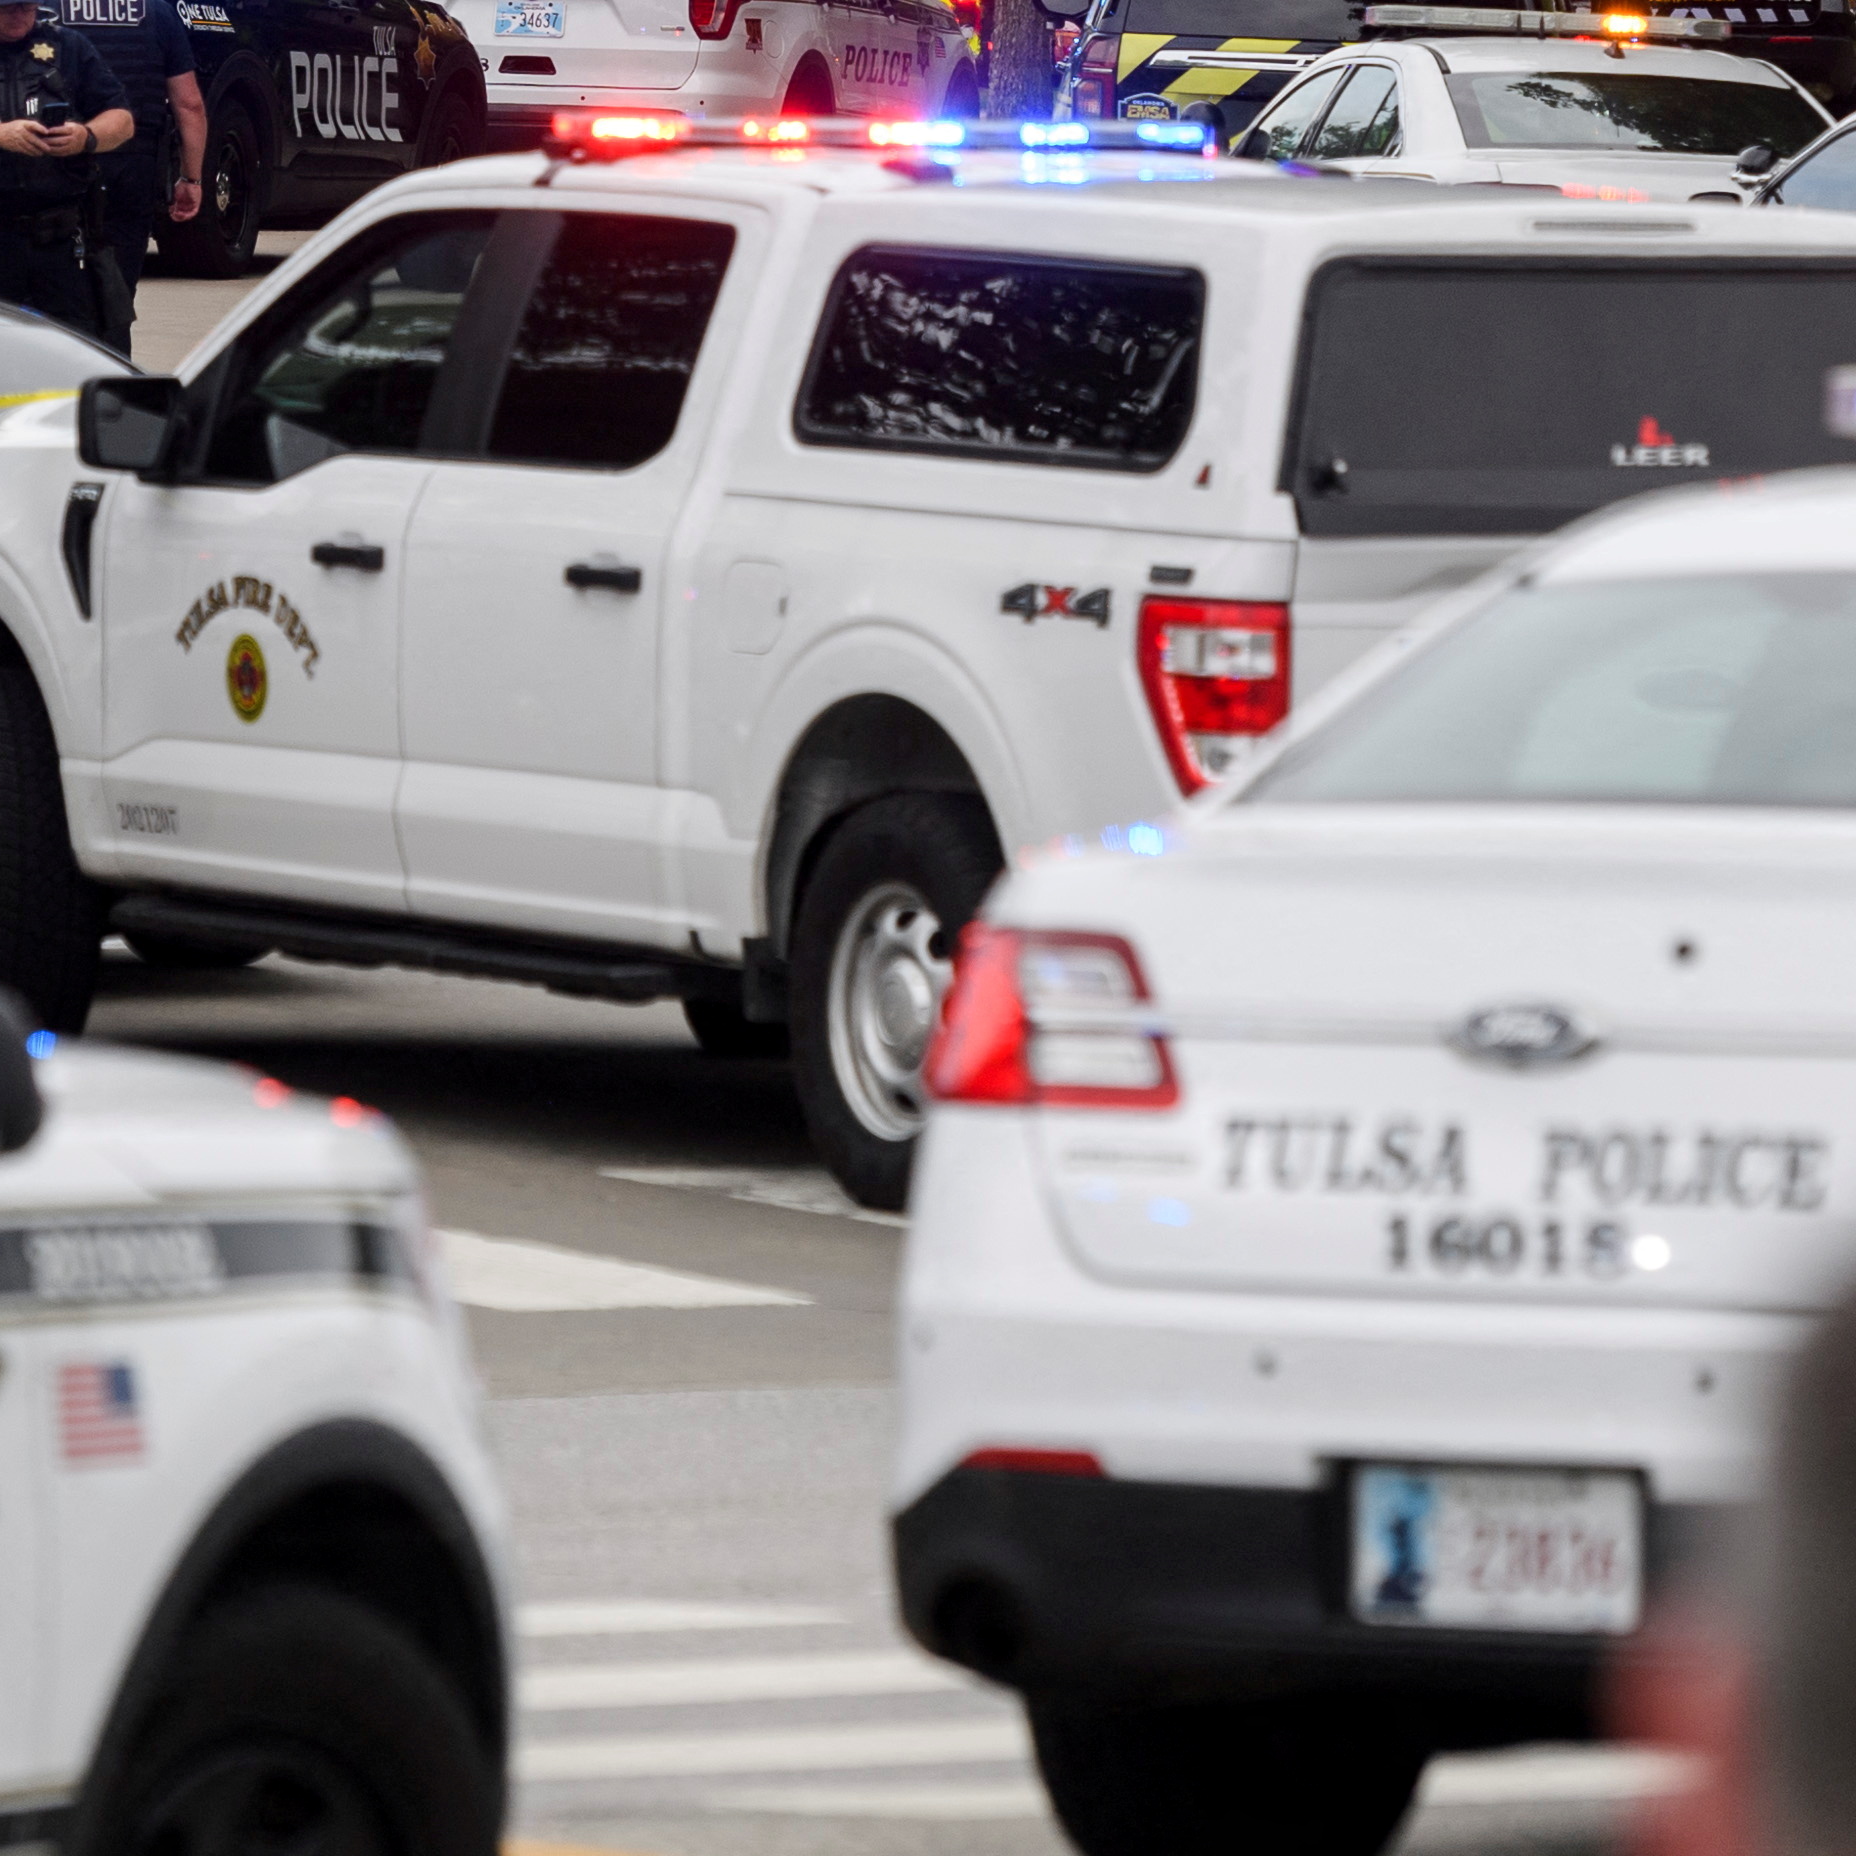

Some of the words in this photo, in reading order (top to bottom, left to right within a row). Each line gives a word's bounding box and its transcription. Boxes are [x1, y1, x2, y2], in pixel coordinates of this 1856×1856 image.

[200, 4, 230, 22] TULSA
[519, 12, 559, 28] 34637
[372, 25, 397, 56] TULSA
[842, 44, 913, 87] POLICE
[289, 50, 404, 143] POLICE
[1610, 441, 1711, 467] LEER
[232, 575, 274, 617] FIRE
[1221, 1114, 1471, 1198] TULSA
[1537, 1126, 1829, 1213] POLICE
